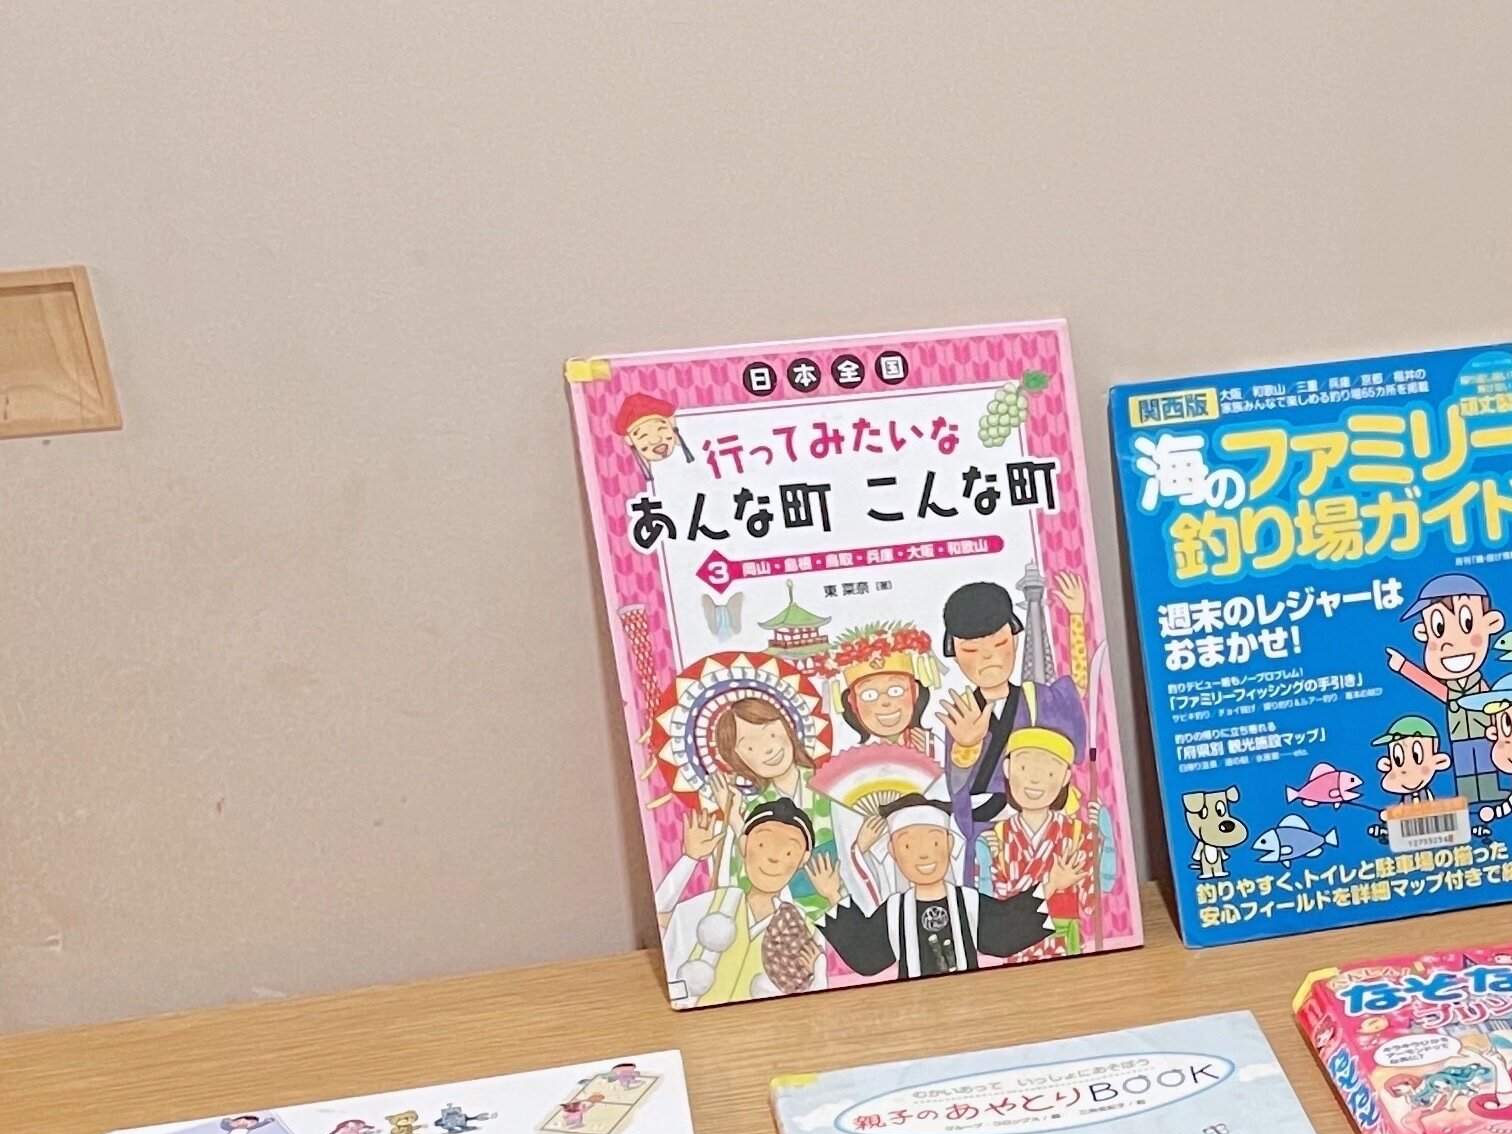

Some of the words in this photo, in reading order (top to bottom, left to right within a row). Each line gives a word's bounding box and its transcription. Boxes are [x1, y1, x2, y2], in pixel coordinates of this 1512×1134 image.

[747, 351, 905, 394] 日本全国
[1138, 392, 1210, 424] 関西版
[701, 415, 961, 480] 行ってみたいな
[630, 481, 833, 548] あんな町
[866, 460, 1058, 519] こんな町
[706, 561, 731, 585] 3
[1157, 577, 1404, 639] 週末のレジャーは
[1164, 626, 1303, 672] おまかせ!
[852, 1062, 1220, 1131] 親子のあやとりBOOK
